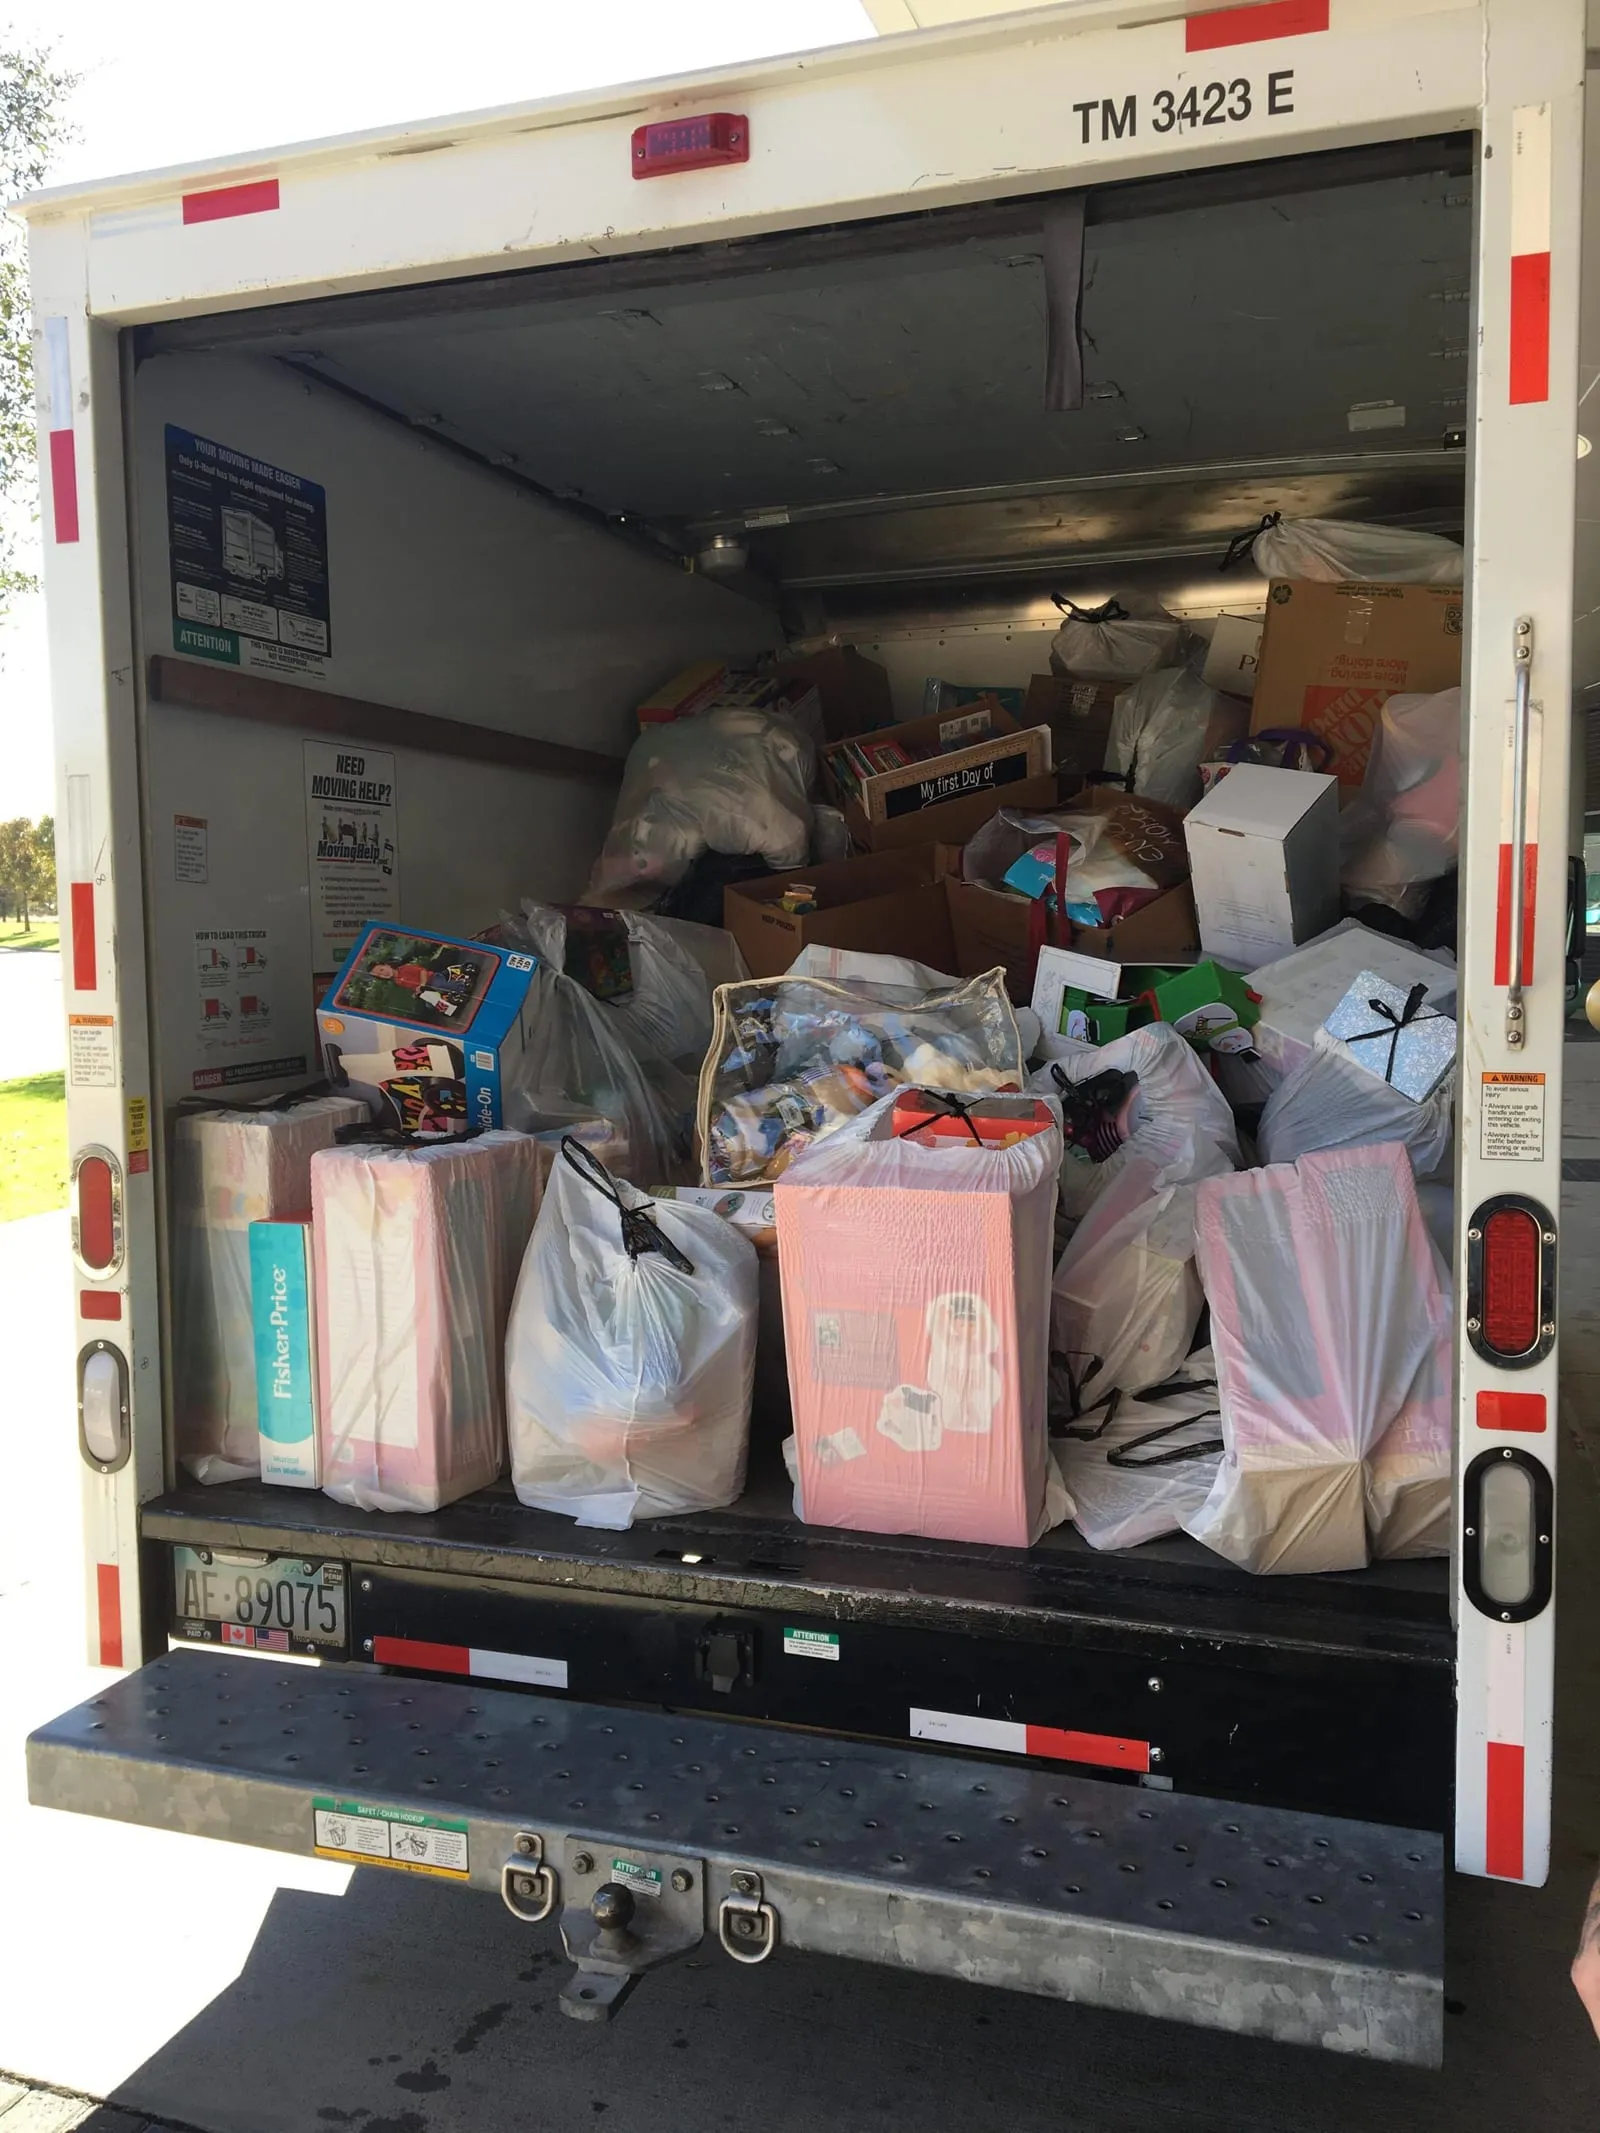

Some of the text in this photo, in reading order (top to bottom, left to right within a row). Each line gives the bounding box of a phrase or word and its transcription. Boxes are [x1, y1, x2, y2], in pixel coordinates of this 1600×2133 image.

[1073, 69, 1294, 143] TM 3423 E
[194, 439, 301, 490] YOUR MOVING MADE EASIER
[180, 630, 232, 653] ATTENTION
[1376, 658, 1409, 671] More
[1374, 671, 1407, 684] More
[336, 754, 365, 776] NEED
[920, 762, 994, 800] My first Day of
[311, 775, 392, 802] MOVING HELP?
[195, 931, 210, 940] HOW
[211, 931, 219, 940] TO
[219, 931, 234, 940] LOAD
[195, 1072, 222, 1086] DANGER
[1501, 1074, 1538, 1083] WARNING
[270, 1266, 292, 1400] Fisher-Price
[186, 1630, 202, 1638] PAID
[792, 1630, 830, 1642] ATTENTION
[400, 1813, 425, 1824] HOOKUP
